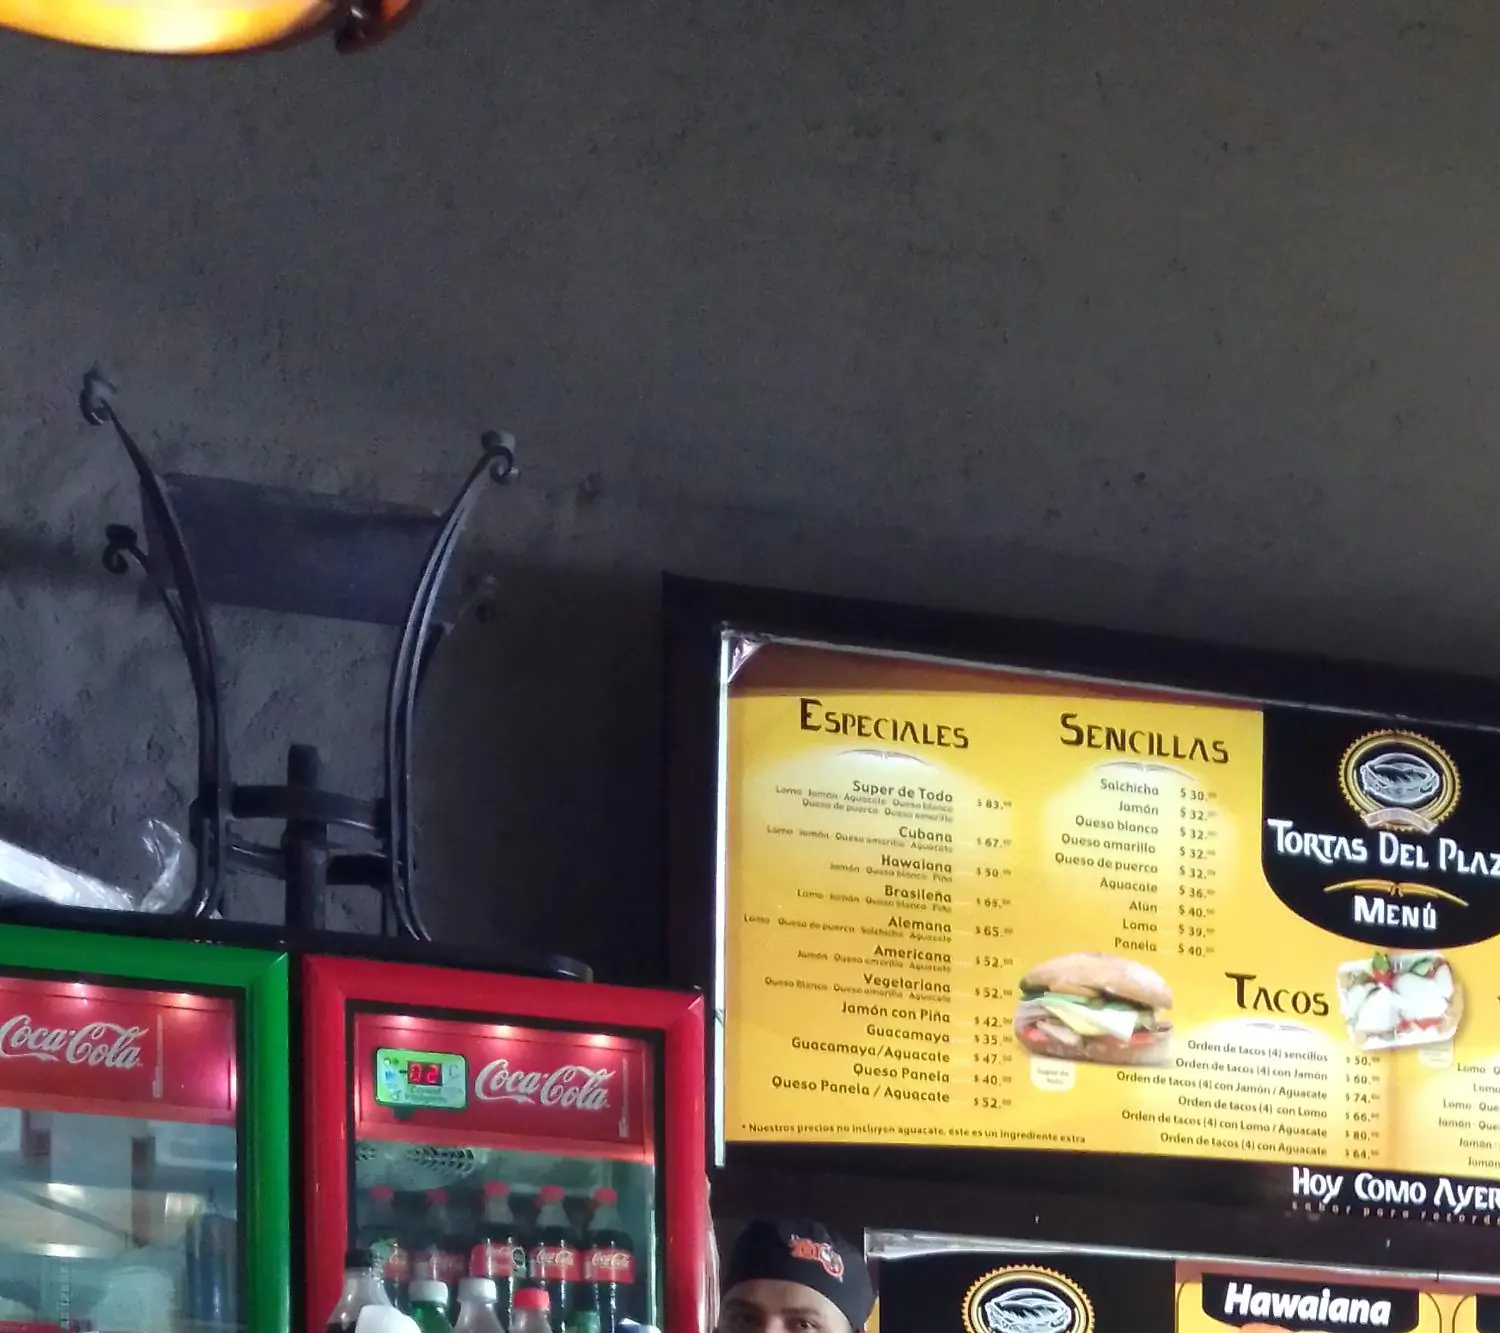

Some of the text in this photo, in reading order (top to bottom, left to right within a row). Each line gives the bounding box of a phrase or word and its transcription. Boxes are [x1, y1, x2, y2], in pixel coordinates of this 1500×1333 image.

[853, 780, 953, 802] Super de Todo
[1100, 778, 1159, 796] Salchicha
[1119, 800, 1159, 815] Jamón
[899, 826, 953, 842] Cubana
[1076, 815, 1158, 834] Queso blanco
[1062, 833, 1156, 854] Queso amarillo
[1267, 818, 1367, 865] TORTAS
[881, 855, 952, 873] Hawaiana
[1055, 852, 1158, 874] Queso de puerco
[884, 885, 952, 903] Brasileña
[1100, 877, 1158, 894] Aguacate
[1354, 894, 1436, 930] MENÚ
[888, 916, 951, 933] Alemana
[1123, 918, 1157, 932] Lomo
[873, 945, 951, 963] Americana
[1114, 937, 1157, 952] Panela
[864, 973, 951, 993] Vegetariana
[1225, 972, 1329, 1016] TACOS
[842, 1001, 950, 1023] Jamón con Piña
[867, 1024, 950, 1044] Guacamaya
[1187, 1039, 1328, 1062] Orden de tacos (4) sencillos
[853, 1063, 950, 1083] Queso Panela
[1175, 1057, 1327, 1081] Orden de tacos (4) con Jamón
[1457, 1063, 1486, 1074] Lomo
[474, 1059, 616, 1110] Coca-Cola
[772, 1075, 817, 1091] Queso
[821, 1079, 869, 1096] Panela
[884, 1086, 950, 1103] Aguacate
[1117, 1071, 1150, 1084] Orden
[1153, 1074, 1166, 1085] de
[1169, 1077, 1196, 1088] tacos
[1199, 1077, 1212, 1090] (4)
[1214, 1081, 1233, 1091] con
[1236, 1081, 1270, 1094] Jamón
[1279, 1085, 1327, 1101] Aguacate
[1473, 1082, 1500, 1094] Lomo
[1178, 1096, 1327, 1119] Orden de tacos (4) con Lomo
[1443, 1099, 1471, 1110] Lomo
[749, 1124, 794, 1133] Nuestros
[797, 1124, 834, 1134] precios
[852, 1125, 895, 1135] incluyen
[972, 1129, 982, 1137] es
[985, 1130, 997, 1138] un
[1000, 1129, 1058, 1142] ingrediente
[1060, 1134, 1086, 1143] extra
[1122, 1110, 1155, 1122] Orden
[1158, 1113, 1171, 1124] de
[1174, 1116, 1201, 1126] tacos
[1203, 1116, 1217, 1128] (4)
[1220, 1120, 1238, 1130] con
[1241, 1119, 1269, 1132] Lomo
[1279, 1124, 1327, 1139] Aguacate
[1160, 1132, 1327, 1158] Orden de tacos (4) con Aguacate
[1224, 1282, 1391, 1325] Hawaiana
